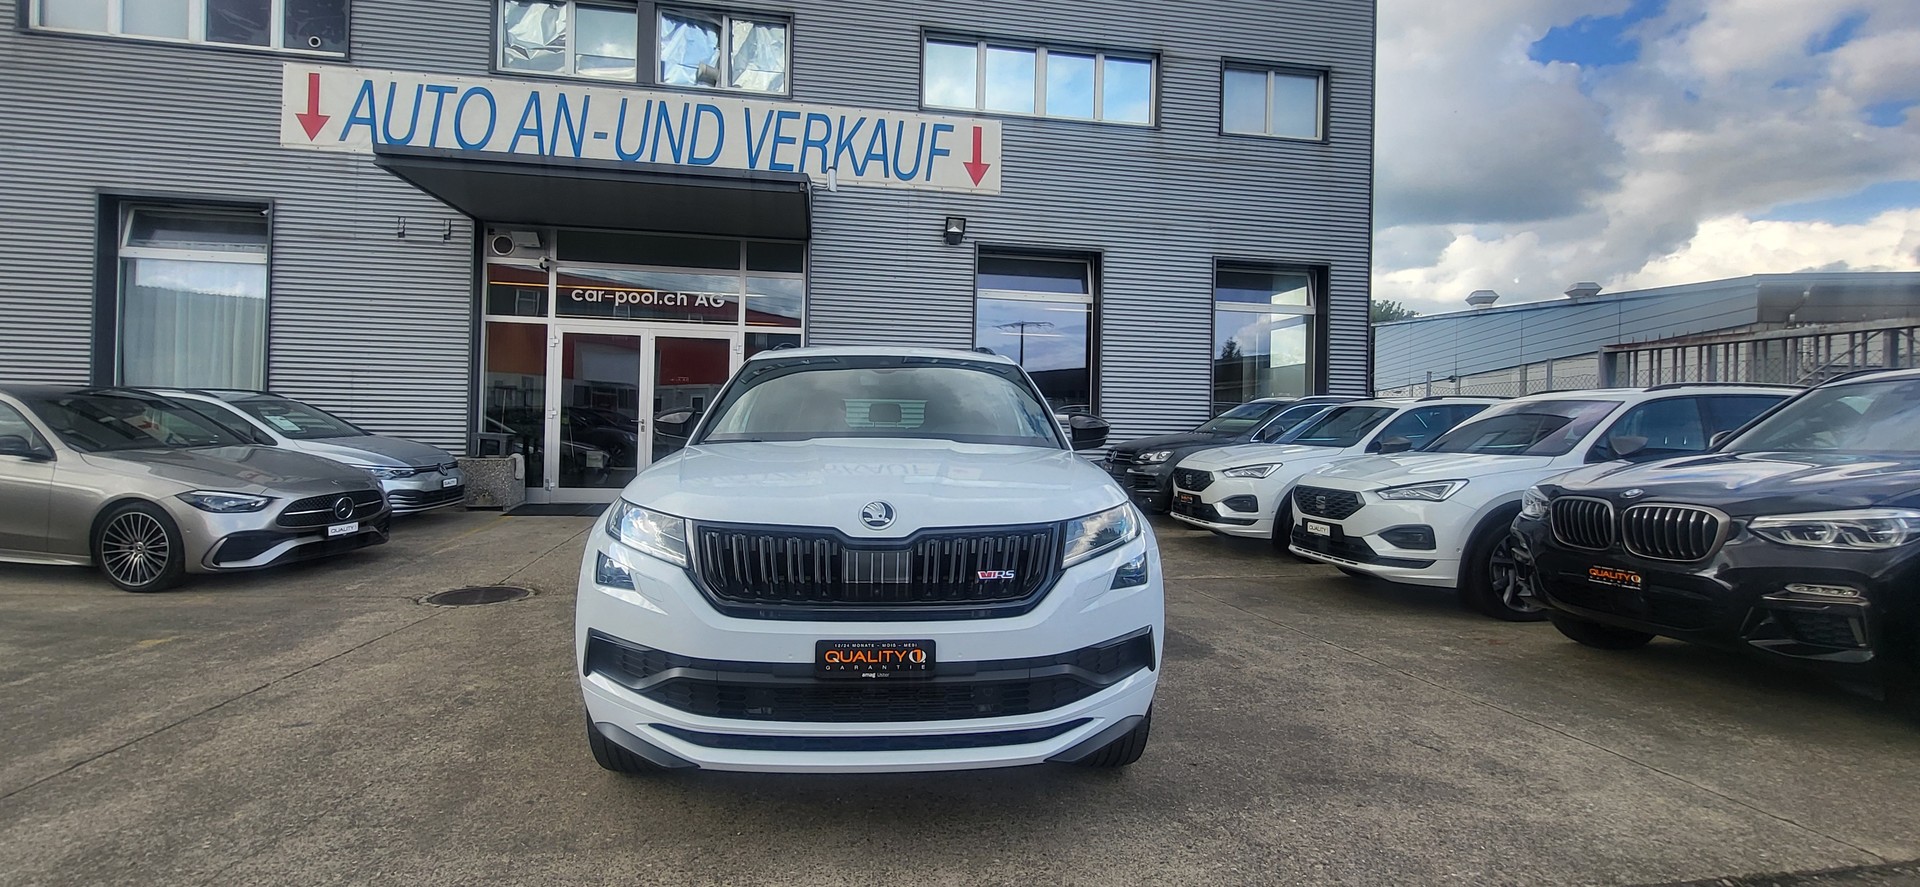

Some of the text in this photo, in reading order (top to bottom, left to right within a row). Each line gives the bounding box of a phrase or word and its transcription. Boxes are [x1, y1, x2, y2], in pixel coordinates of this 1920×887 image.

[338, 79, 497, 151] AUTO
[744, 107, 955, 182] VERKAUF
[571, 289, 725, 308] car-pool.ch AG
[1589, 568, 1630, 581] QUALITY
[825, 650, 907, 663] QUALITY
